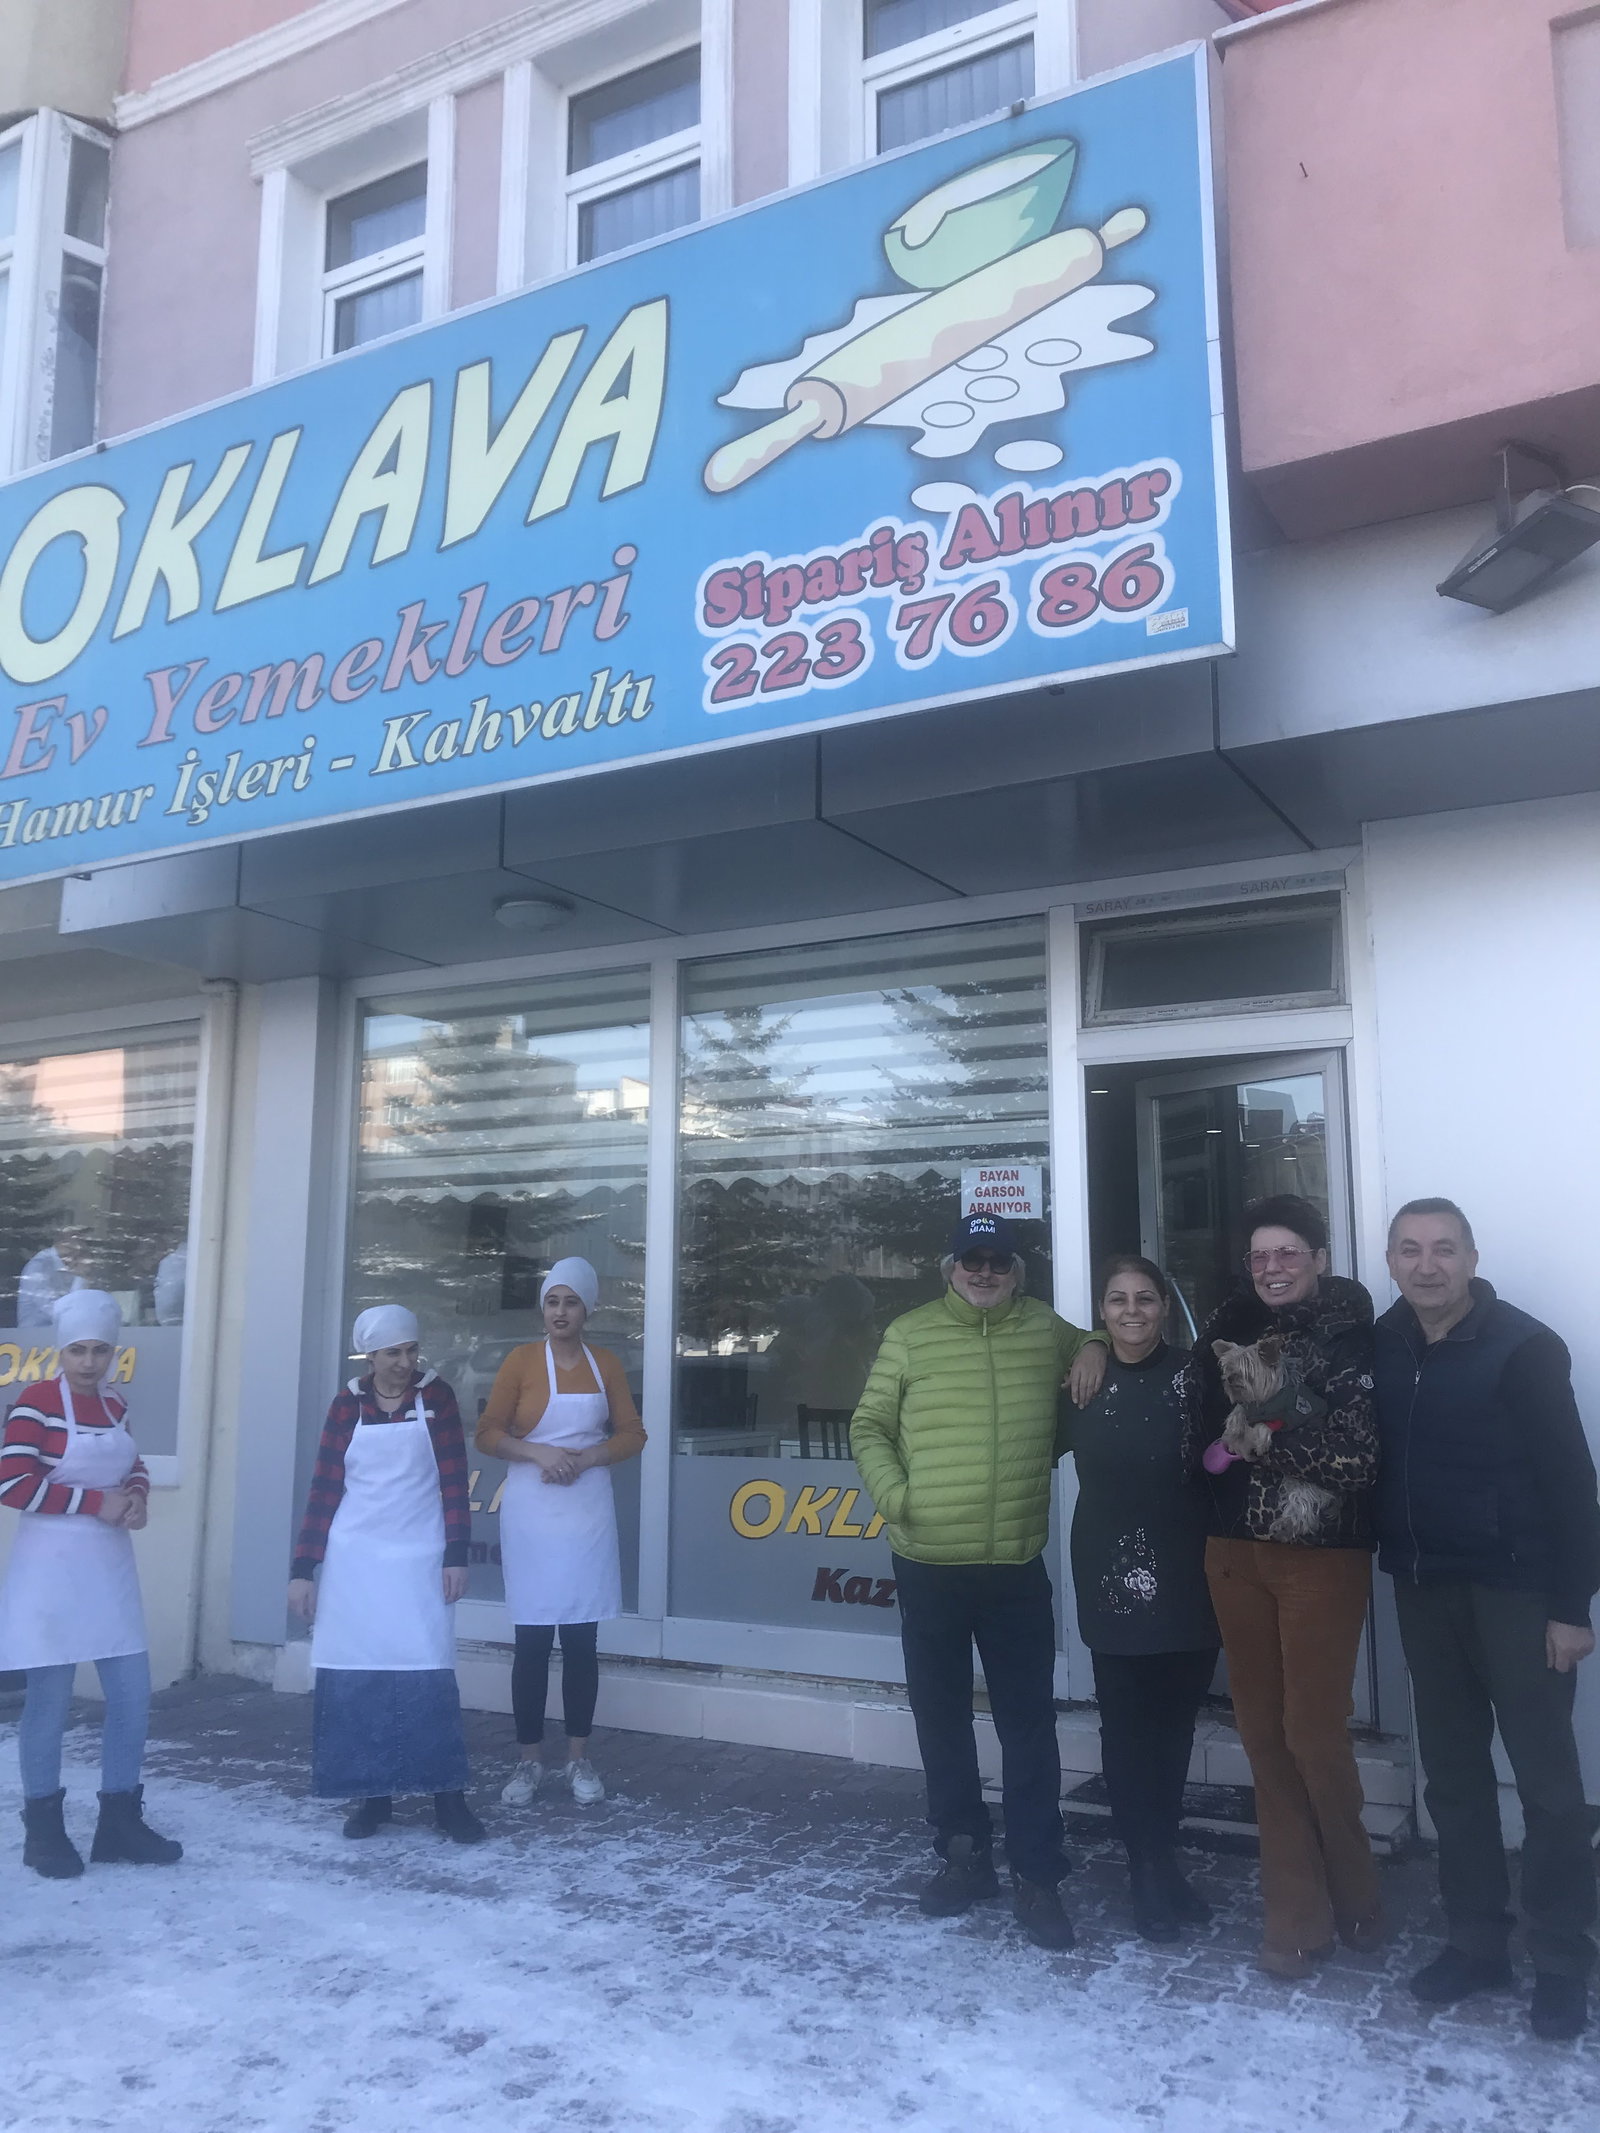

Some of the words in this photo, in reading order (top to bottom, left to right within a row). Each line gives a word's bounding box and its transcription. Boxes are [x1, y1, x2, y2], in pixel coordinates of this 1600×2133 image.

[0, 294, 670, 686] OKLAVA
[703, 526, 929, 628] Sipariş
[940, 467, 1172, 571] Alınır
[710, 617, 867, 705] 223
[896, 580, 1009, 661] 76
[1036, 542, 1165, 628] 86
[1, 693, 109, 780] Ev
[137, 544, 640, 750] Yemekleri
[0, 783, 155, 849] Hamur
[164, 734, 317, 826] İşleri
[370, 667, 656, 777] Kahvaltı
[1239, 878, 1289, 896] SARAY
[1086, 899, 1131, 915] SARAY
[980, 1170, 1019, 1181] BAYAN
[975, 1186, 1025, 1197] GARSON
[969, 1202, 1032, 1213] ARANIYOR
[969, 1224, 996, 1235] MIAMI
